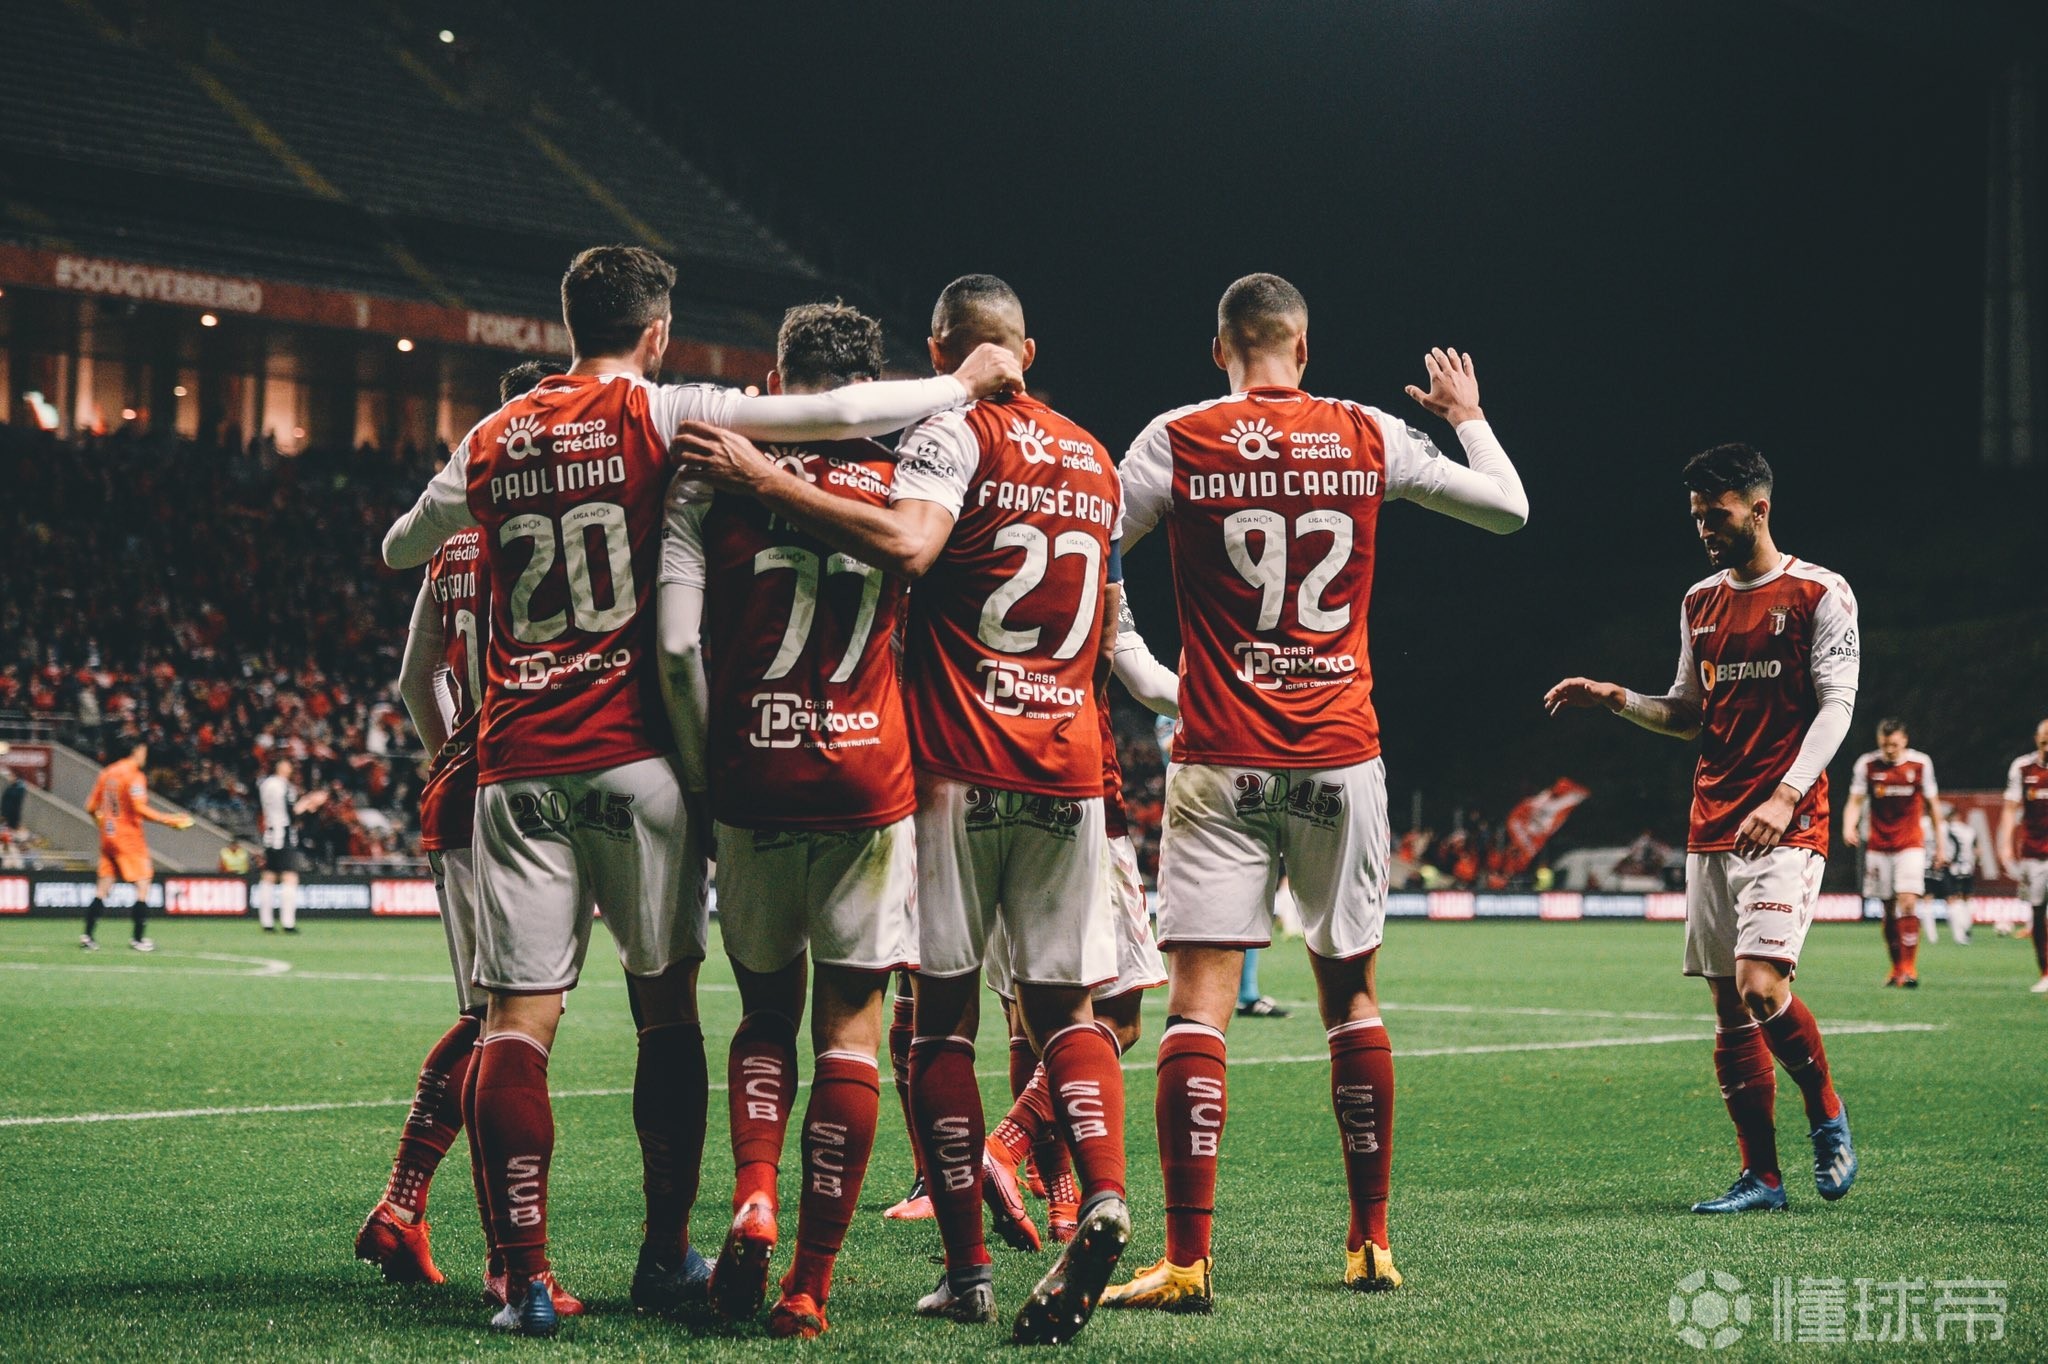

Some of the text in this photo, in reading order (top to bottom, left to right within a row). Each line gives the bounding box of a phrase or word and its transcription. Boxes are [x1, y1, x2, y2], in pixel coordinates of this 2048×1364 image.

[552, 418, 606, 436] amco
[1289, 431, 1340, 444] amco
[552, 432, 617, 453] crédito
[1058, 438, 1094, 456] amco
[1291, 442, 1352, 459] crédito
[1062, 452, 1102, 475] crédito
[491, 455, 626, 504] PAULINHO
[1190, 471, 1378, 500] DAVID CARMO
[573, 512, 589, 520] LIGA
[978, 481, 1113, 529] FRANSÉRGIO
[1253, 515, 1272, 525] NOS
[1324, 515, 1342, 525] NOS
[446, 532, 479, 545] amco
[446, 545, 480, 561] crédito
[768, 553, 785, 561] LIGA
[499, 502, 637, 644] 20
[1223, 508, 1354, 632] 92
[978, 523, 1101, 659] 27
[754, 546, 883, 682] 77
[1283, 646, 1314, 655] CASA
[1830, 646, 1860, 657] SABS
[1027, 672, 1056, 684] CASA
[1244, 651, 1356, 681] Peixoto
[1716, 660, 1782, 682] BETANO
[1285, 682, 1308, 691] IDEIAS
[805, 700, 834, 710] CASA
[1026, 711, 1050, 719] IDEIAS
[761, 703, 879, 738] Peixoto
[964, 786, 1083, 827] 2045
[1234, 772, 1344, 818] 2045
[509, 788, 634, 830] 2045
[741, 1055, 783, 1122] SCB
[1060, 1080, 1108, 1143] SCB
[1186, 1076, 1222, 1157] SCB
[1336, 1084, 1379, 1154] SCB
[808, 1121, 848, 1199] SCB
[931, 1116, 975, 1192] SCB
[506, 1154, 541, 1228] SCB
